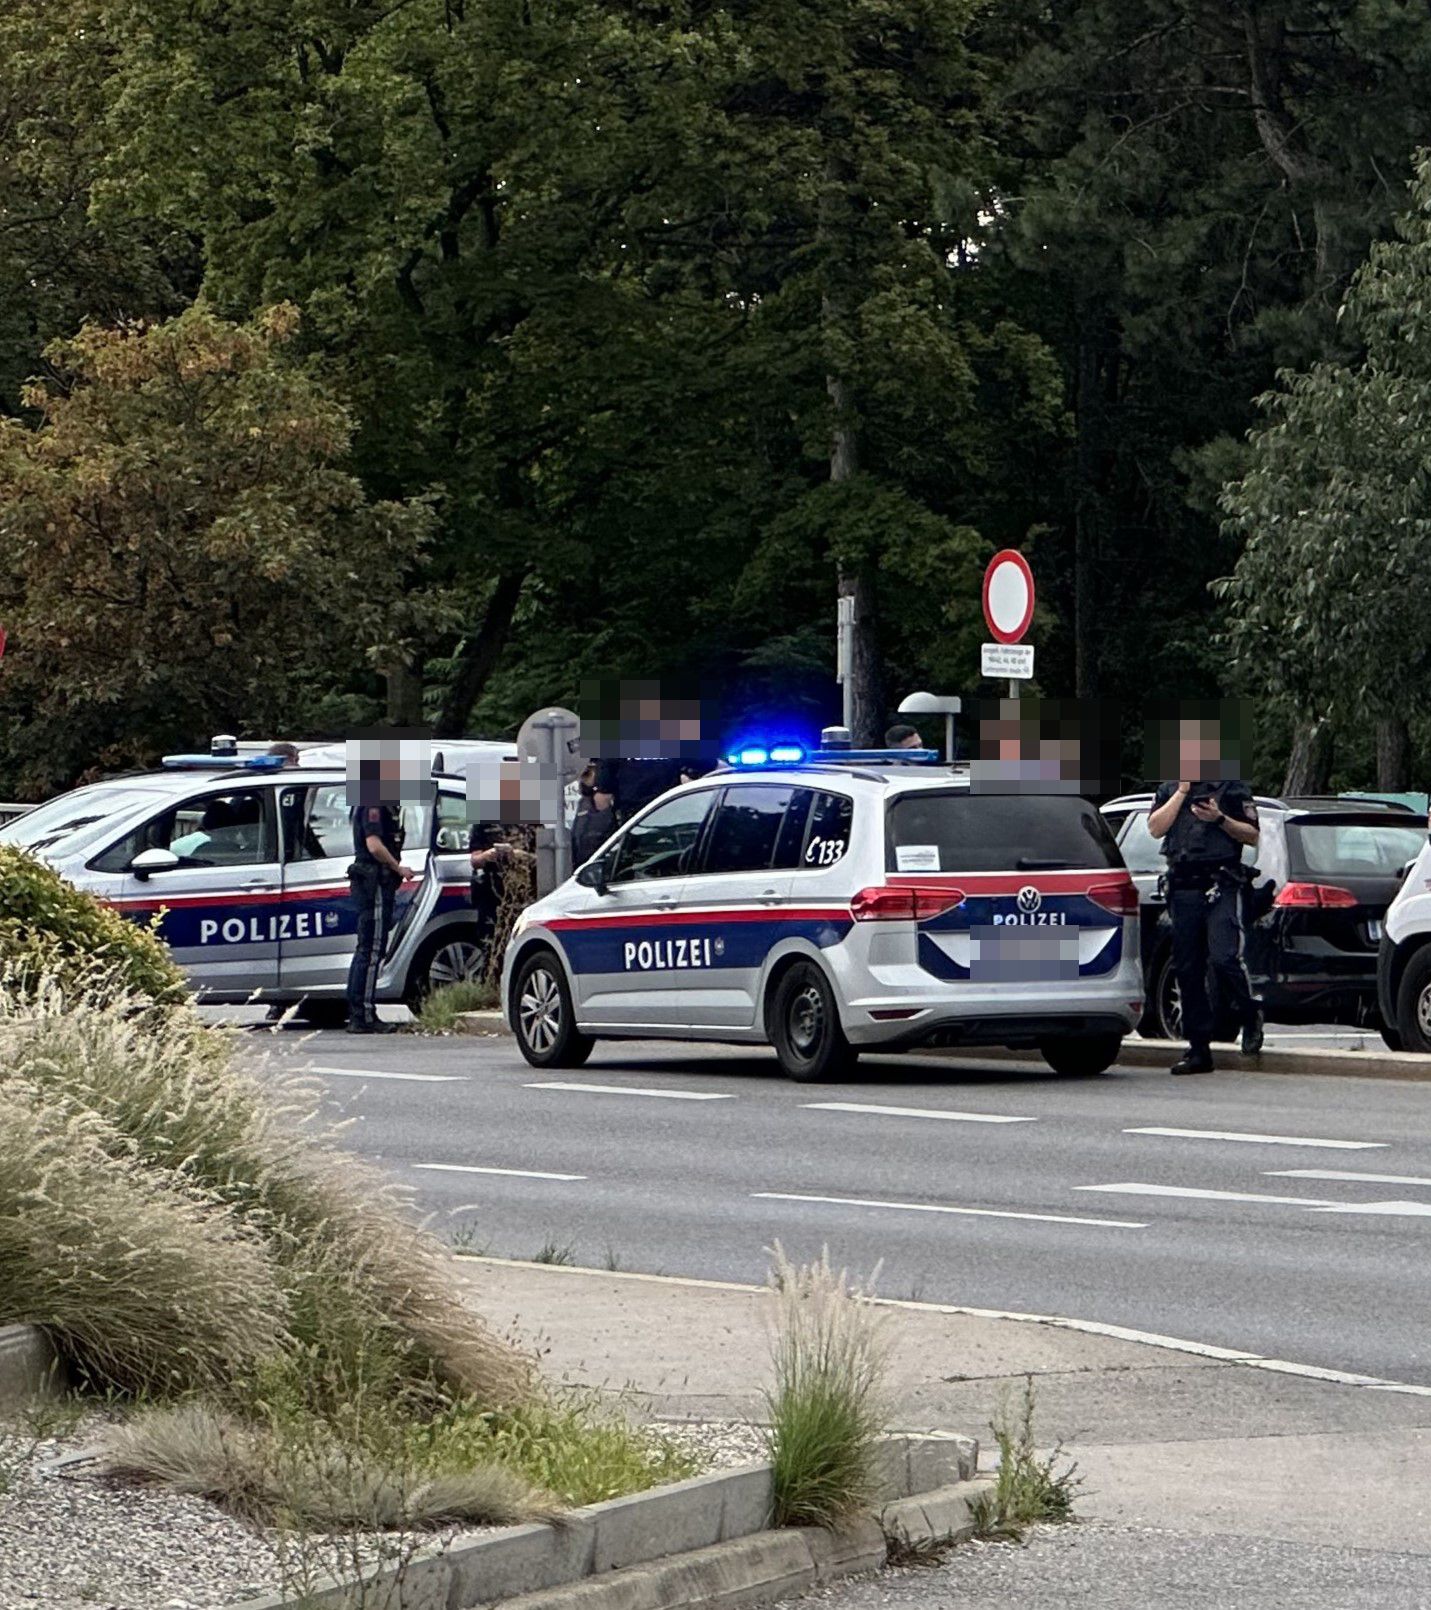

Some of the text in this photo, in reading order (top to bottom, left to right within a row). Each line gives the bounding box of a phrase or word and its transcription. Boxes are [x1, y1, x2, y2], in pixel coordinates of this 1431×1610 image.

[818, 840, 845, 864] 133
[200, 912, 322, 943] POLIZEI
[993, 912, 1066, 926] POLIZEI
[624, 938, 711, 970] POLIZEI
